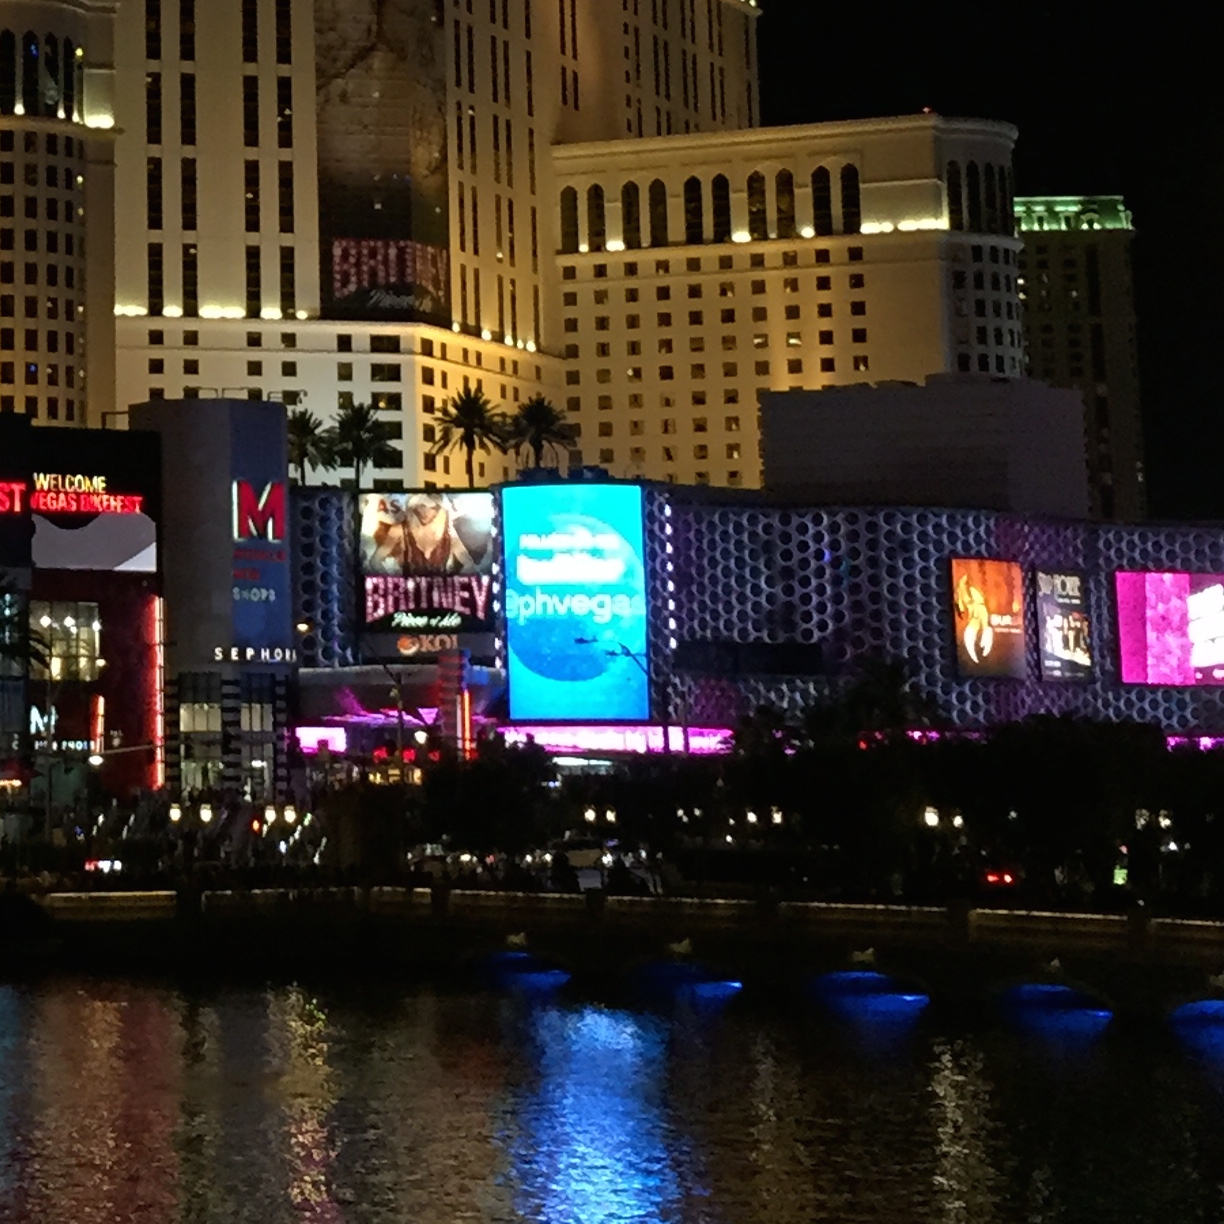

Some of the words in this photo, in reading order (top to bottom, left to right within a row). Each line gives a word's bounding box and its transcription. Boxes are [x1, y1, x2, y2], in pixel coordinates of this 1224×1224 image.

[33, 472, 107, 494] WELCOME
[80, 494, 143, 514] BIKEFEST
[232, 480, 286, 543] M
[365, 575, 490, 623] BRITNEY
